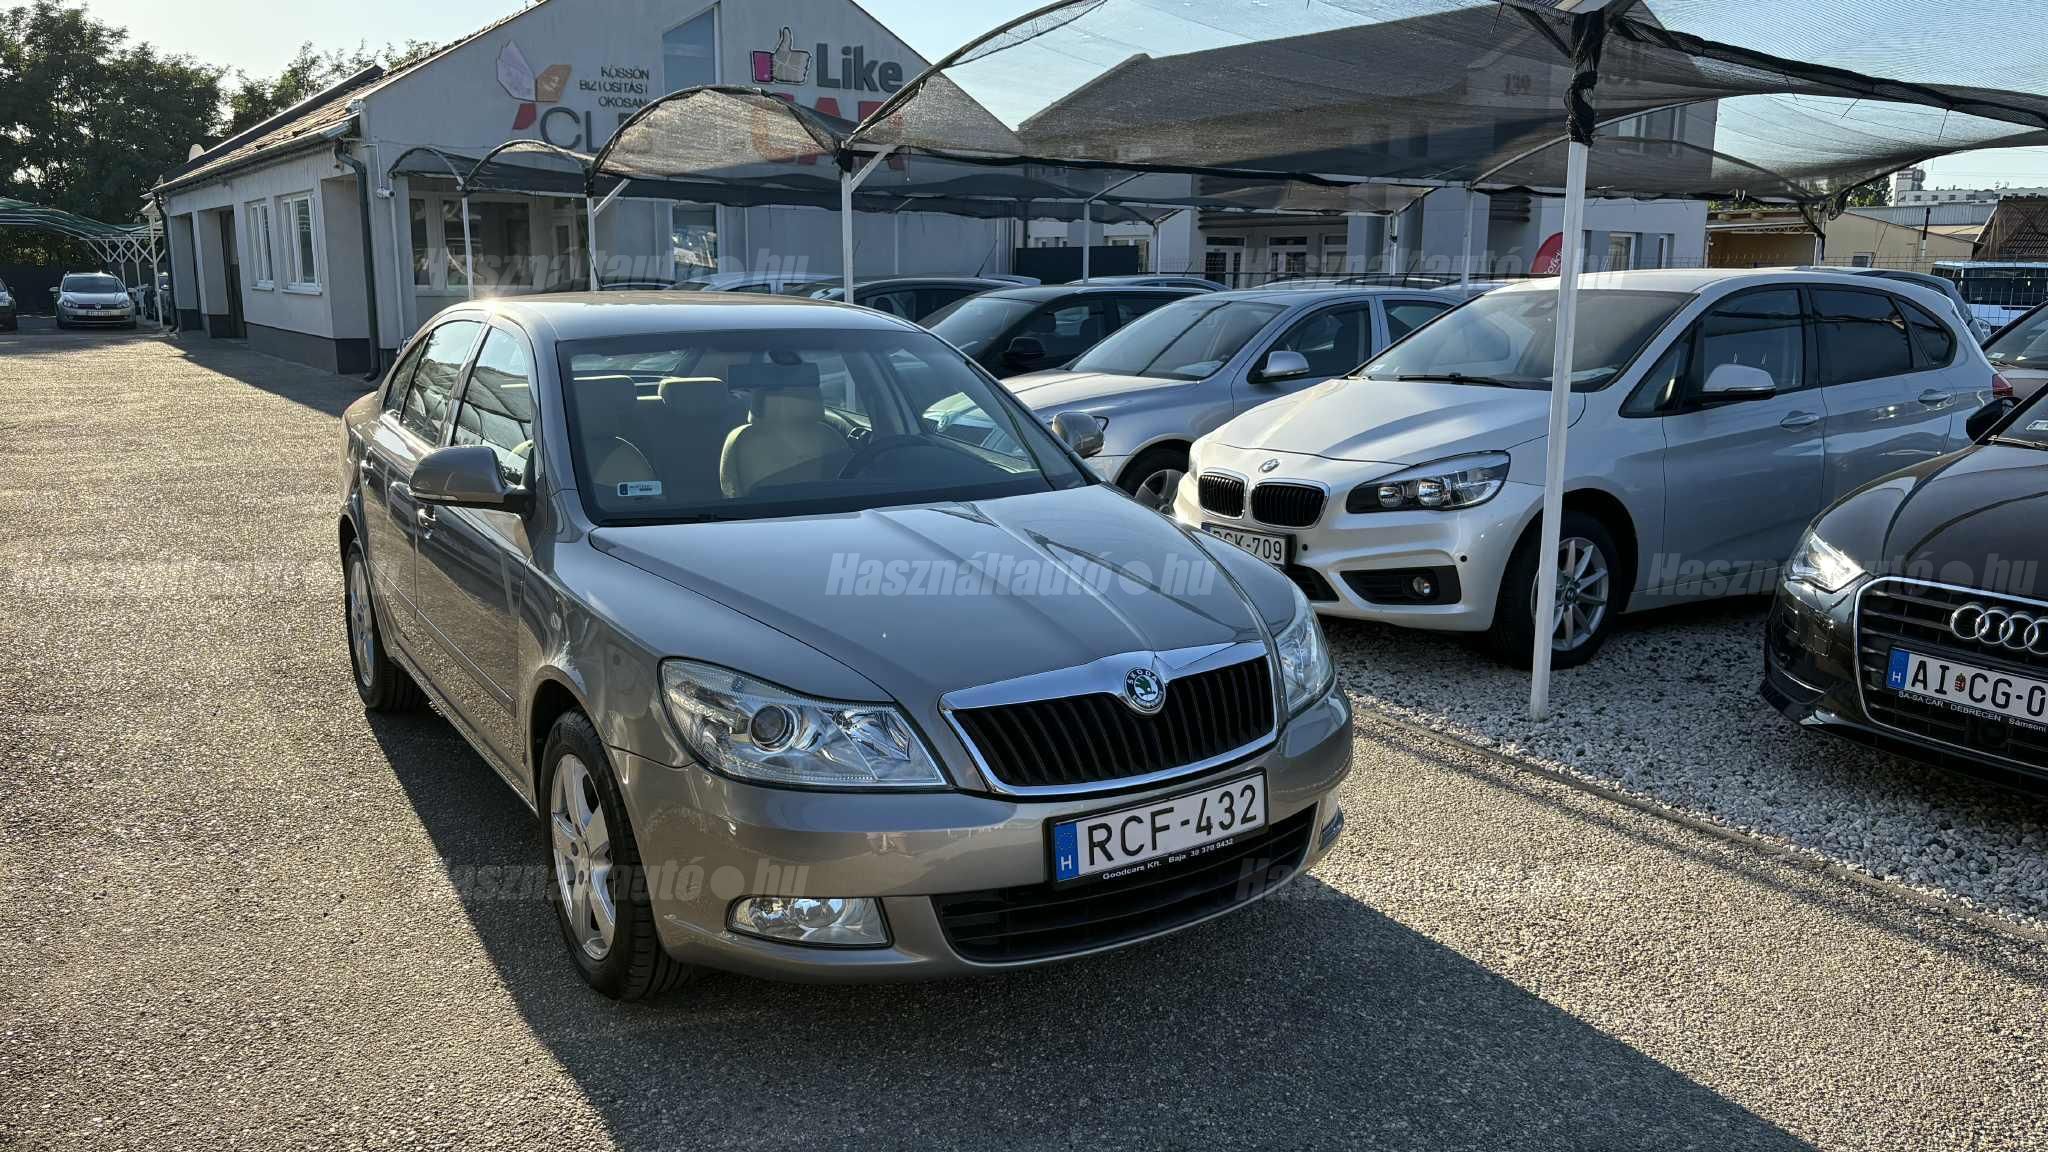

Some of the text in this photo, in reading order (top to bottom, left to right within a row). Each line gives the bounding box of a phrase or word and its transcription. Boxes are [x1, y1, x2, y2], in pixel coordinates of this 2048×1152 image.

[816, 43, 904, 93] Like
[1891, 671, 1902, 683] H
[1910, 660, 1950, 695] AI
[1950, 703, 2001, 722] DEBRECEN
[1087, 784, 1258, 866] RCF-432
[1060, 856, 1073, 872] H
[1102, 864, 1146, 880] Goodcars
[1168, 853, 1187, 863] Baja
